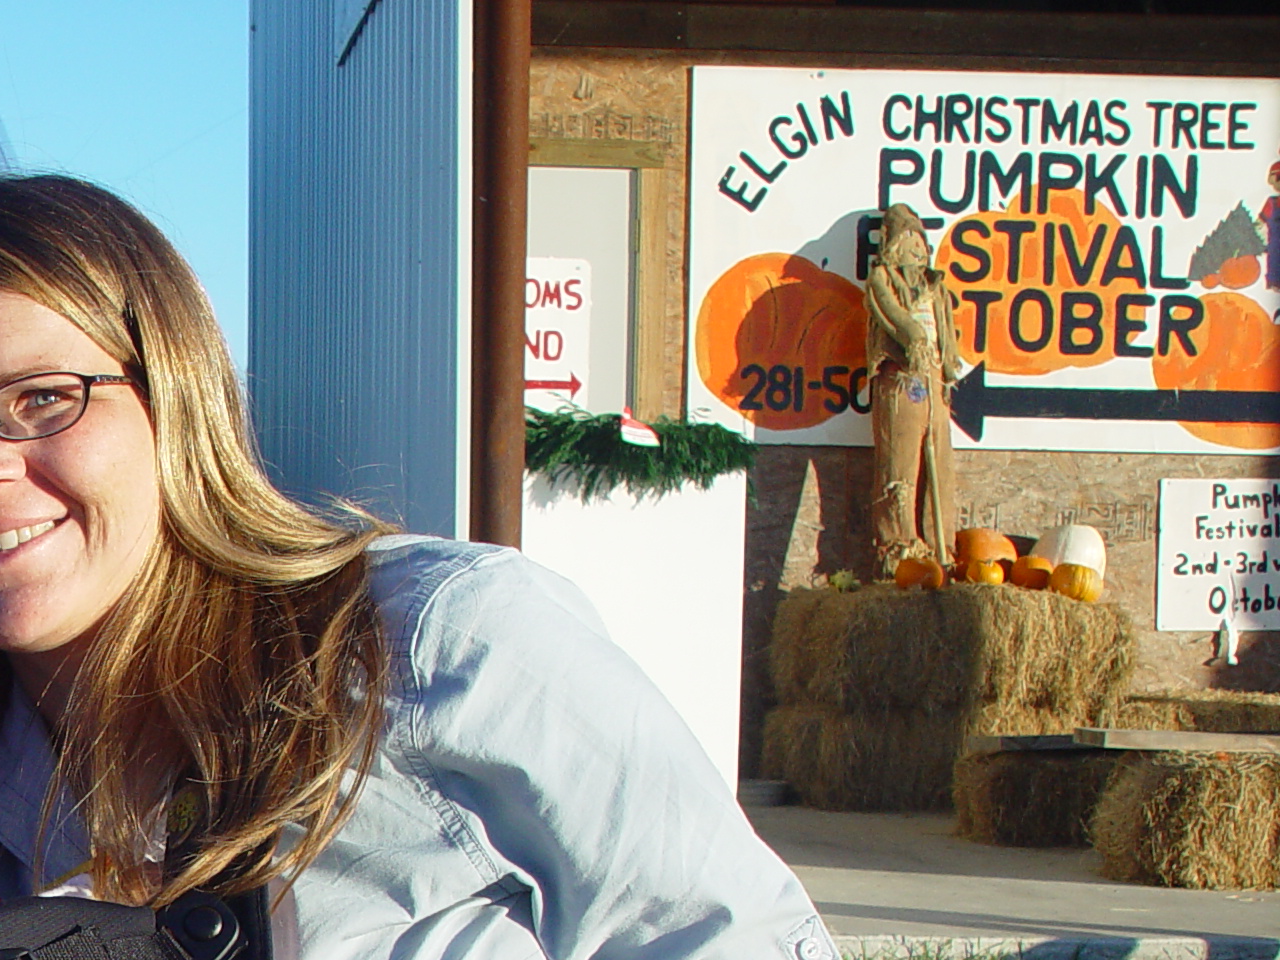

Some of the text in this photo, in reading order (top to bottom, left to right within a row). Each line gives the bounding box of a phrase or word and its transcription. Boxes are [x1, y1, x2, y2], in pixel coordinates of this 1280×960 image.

[718, 90, 854, 213] ELGIN
[882, 93, 1131, 147] CHRISTMAS
[1146, 101, 1258, 150] TREE
[878, 147, 1198, 219] PUMPKIN
[855, 214, 1191, 290] FSTIVAL
[949, 287, 1204, 358] TOBER
[1208, 584, 1280, 615] Otob
